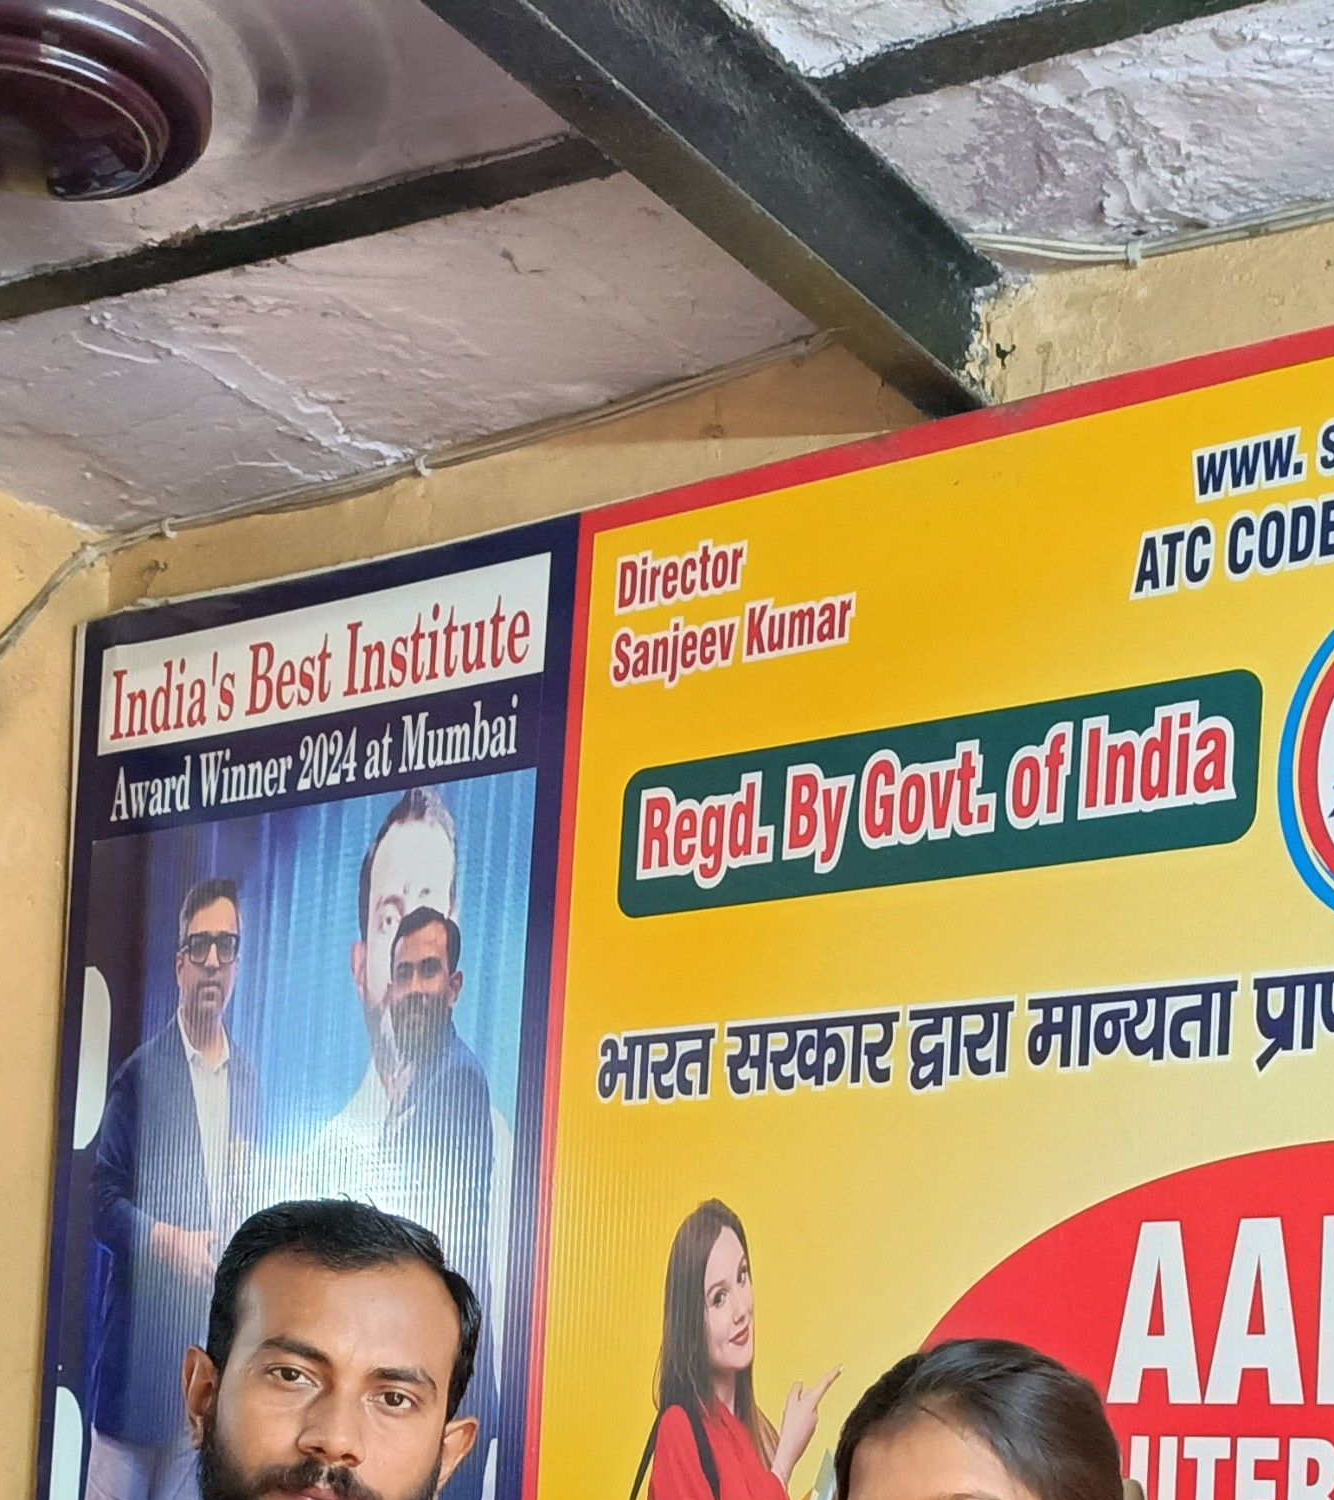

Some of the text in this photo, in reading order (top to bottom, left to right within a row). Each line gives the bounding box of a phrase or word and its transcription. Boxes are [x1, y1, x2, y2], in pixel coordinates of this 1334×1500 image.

[1195, 428, 1305, 496] www.
[618, 542, 744, 608] Director
[1135, 528, 1211, 595] ATC
[110, 595, 531, 742] India's Best Institute
[612, 594, 854, 683] Sanjeev Kumar
[110, 694, 520, 822] Award Winner 2024 at Mumbai
[641, 710, 1229, 881] Regd. By Govt. of India
[597, 1027, 715, 1101] भारत
[727, 1012, 900, 1096] सरकार
[909, 999, 1015, 1090] द्वारा
[1028, 979, 1239, 1070] मान्यता
